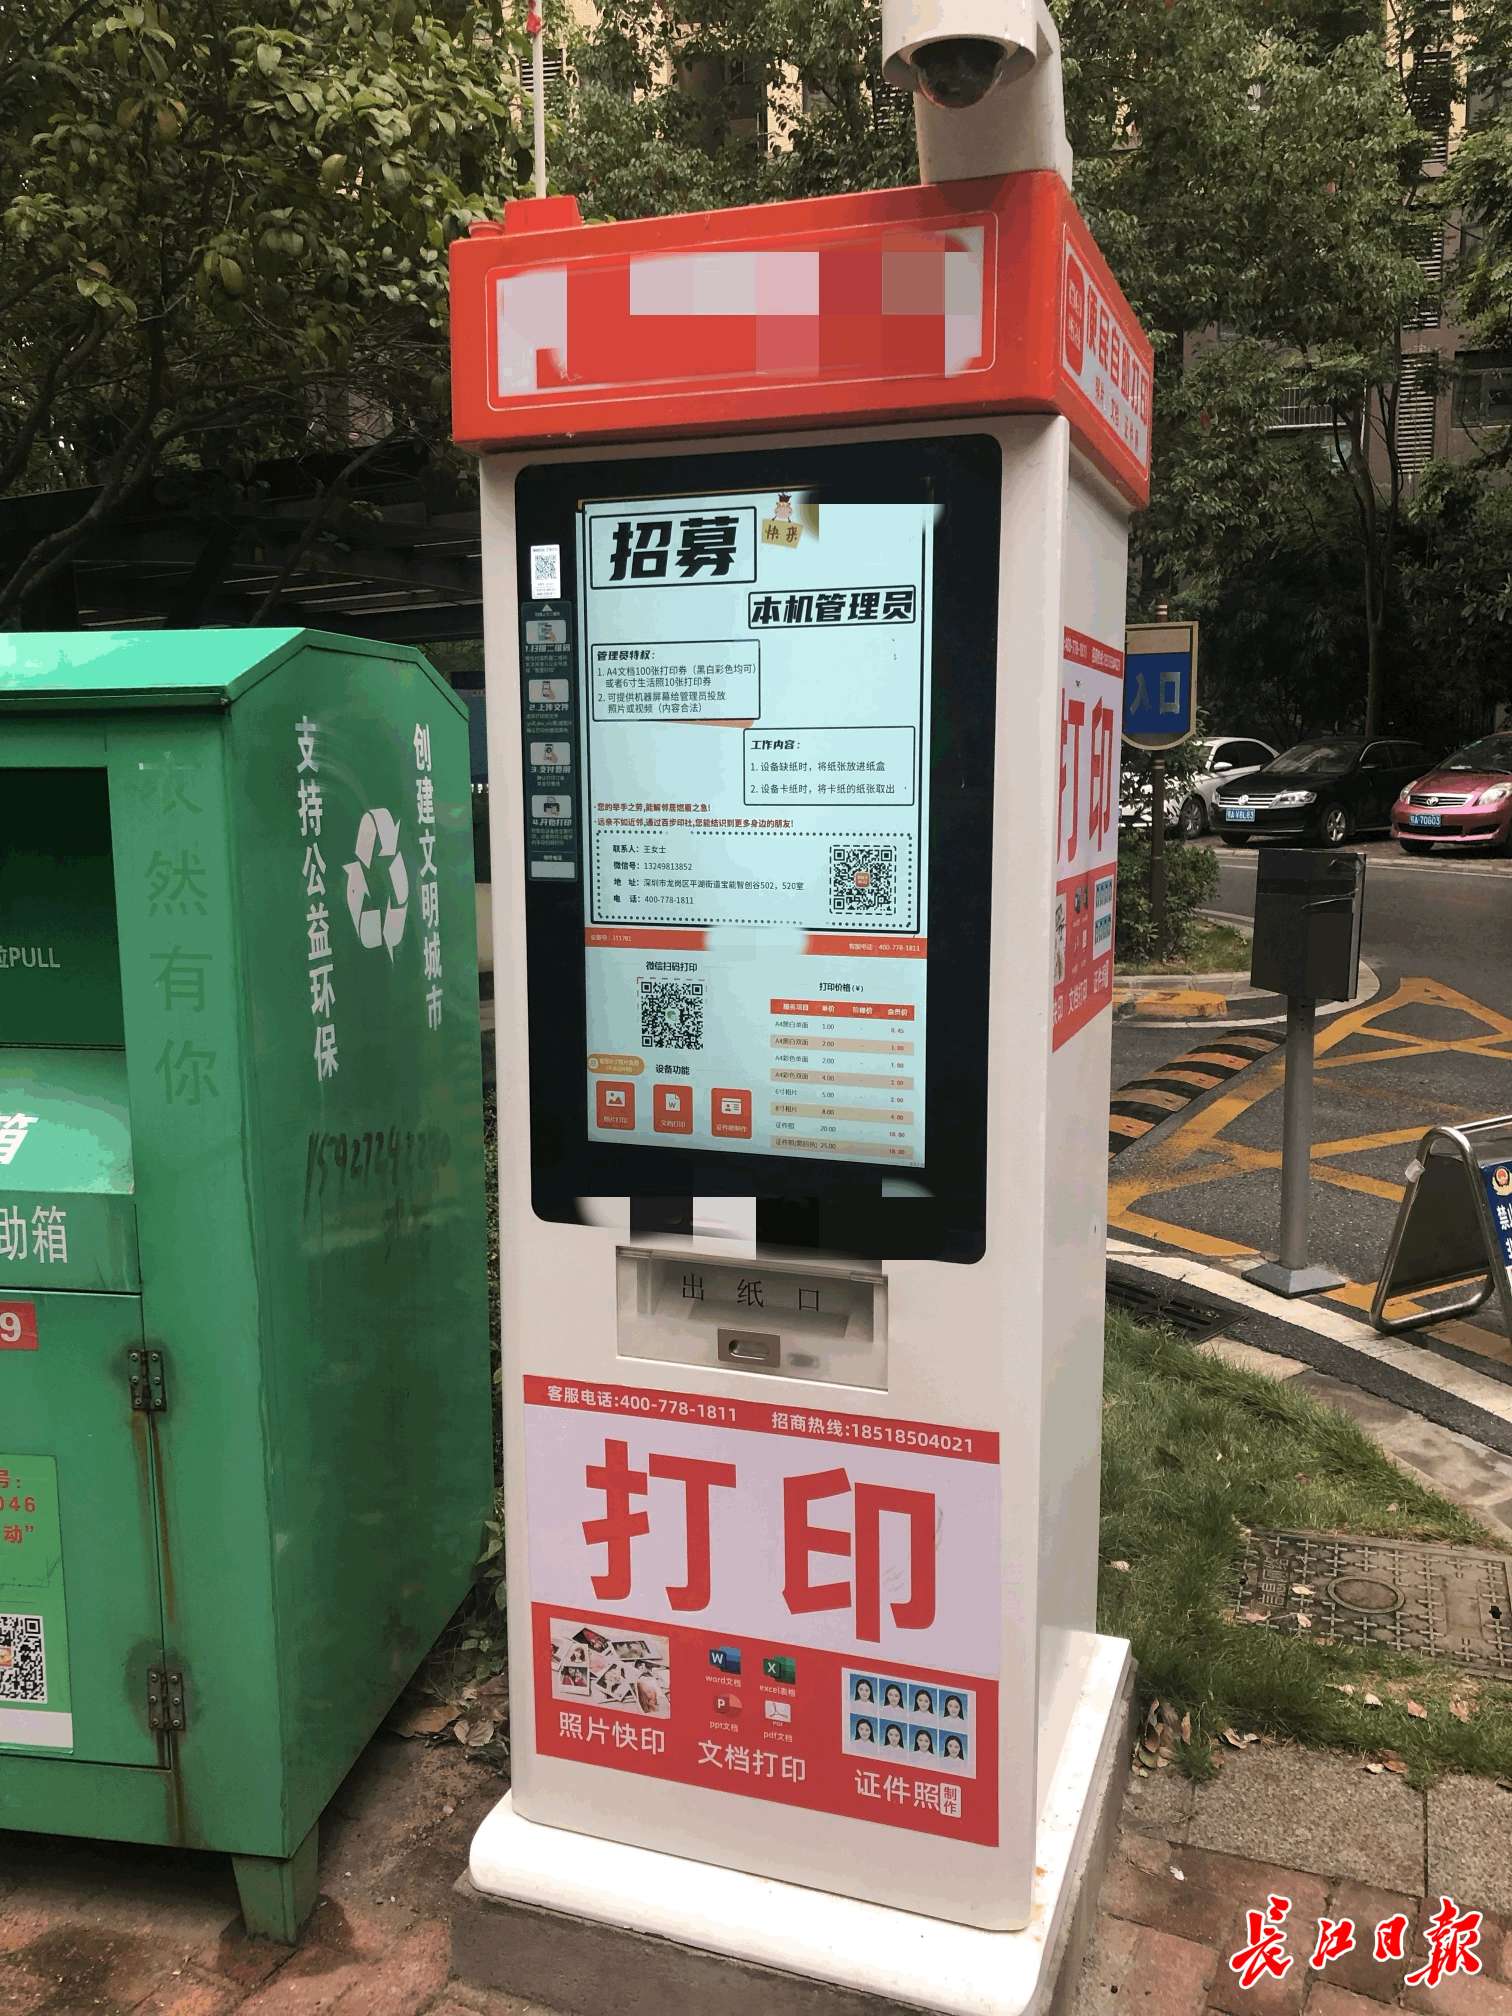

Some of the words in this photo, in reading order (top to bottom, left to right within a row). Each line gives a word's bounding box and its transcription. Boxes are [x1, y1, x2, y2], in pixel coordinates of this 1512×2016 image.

[609, 516, 739, 581] 招募
[751, 591, 914, 625] 本机管理员
[605, 677, 712, 688] 或者6寸生活照10张打印券
[608, 691, 726, 702] 可提供机器屏幕给管理员投放
[1130, 671, 1181, 715] 入口
[413, 722, 443, 1031] 创建文明城市
[295, 715, 339, 1082] 支持公益环保
[646, 961, 698, 972] 微信扫码打印
[655, 1064, 691, 1076] 设备功能
[581, 1438, 937, 1644] 打印
[705, 1674, 742, 1688] word文档
[558, 1711, 666, 1755] 照片快印
[709, 1720, 739, 1733] ppt文档
[763, 1731, 793, 1743] pdf文档
[697, 1739, 806, 1784] 文档打印
[854, 1769, 941, 1812] 证件照
[943, 1785, 958, 1816] 制作
